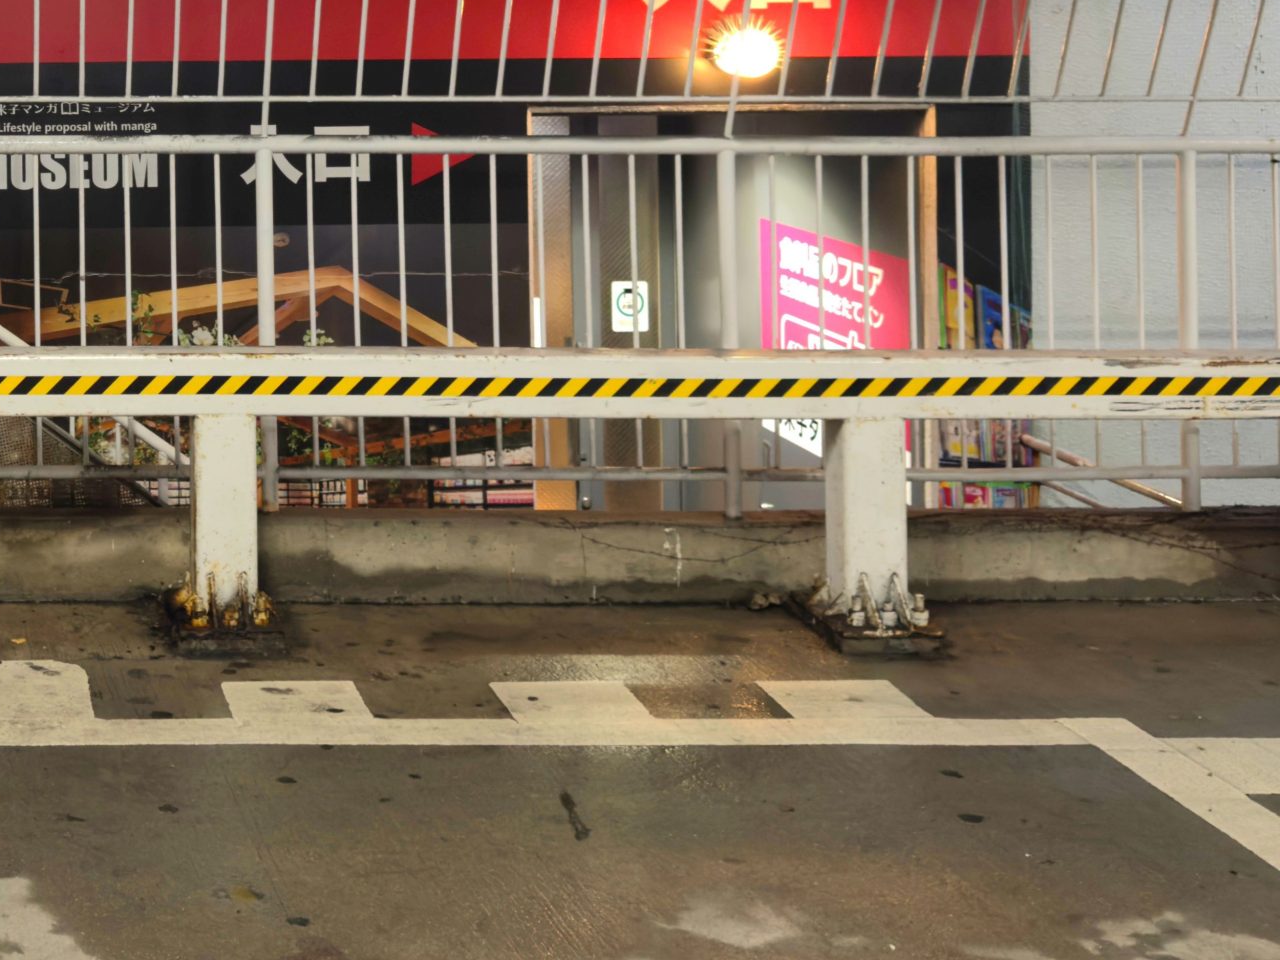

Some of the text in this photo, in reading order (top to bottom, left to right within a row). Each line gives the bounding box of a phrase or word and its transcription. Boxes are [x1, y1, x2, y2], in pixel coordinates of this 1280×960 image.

[45, 121, 91, 135] proposal
[94, 121, 118, 132] with
[120, 122, 157, 134] manga
